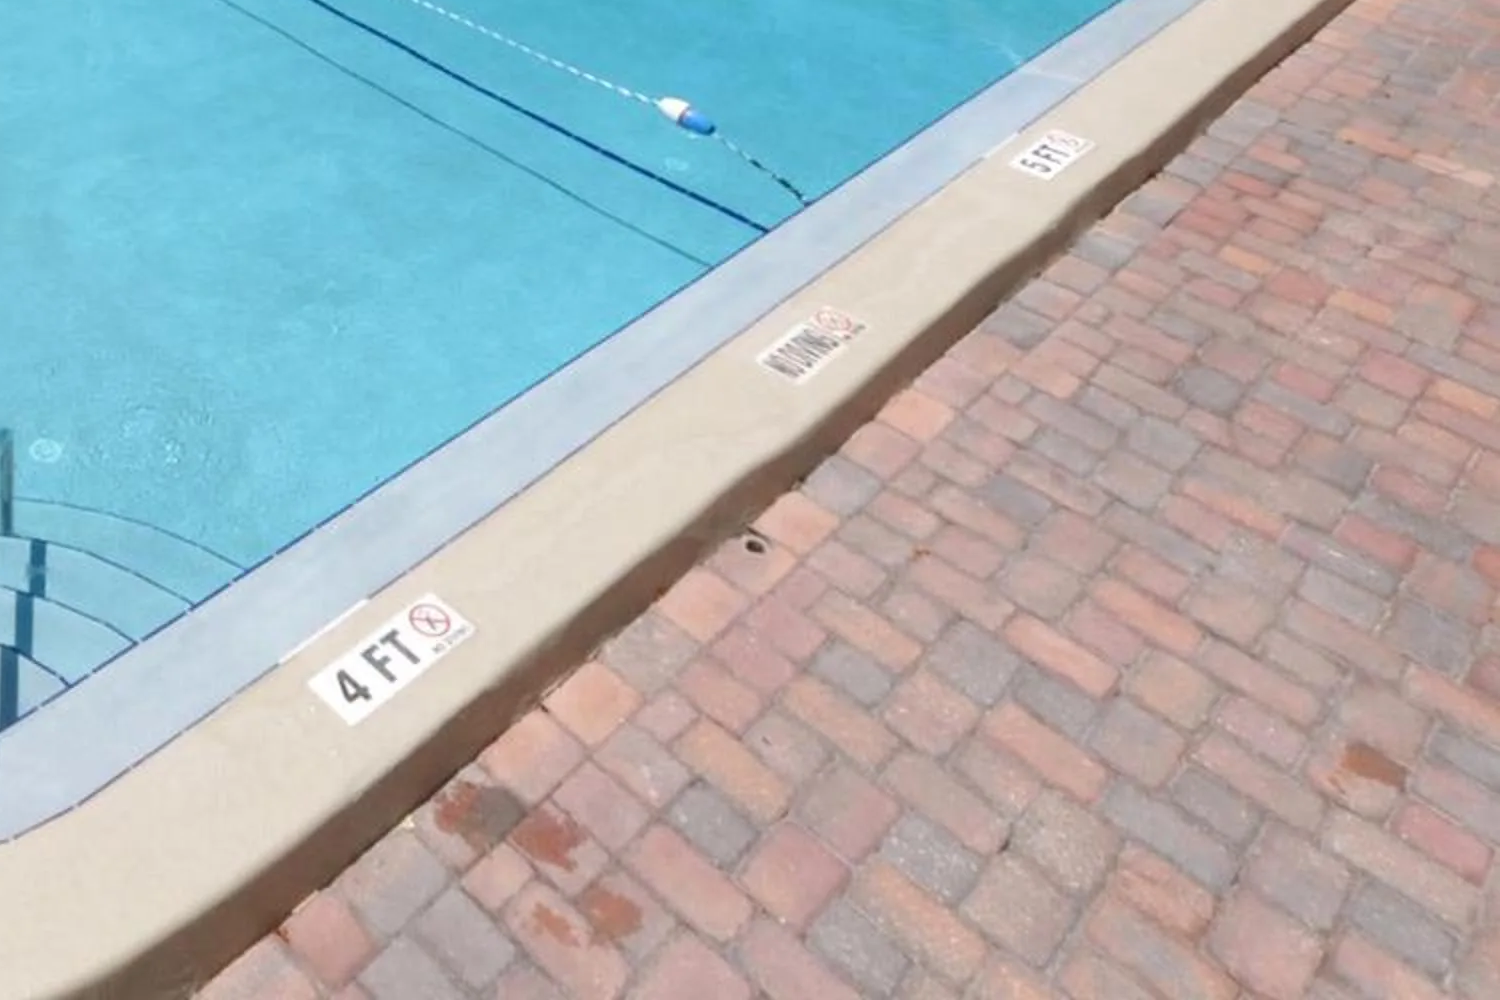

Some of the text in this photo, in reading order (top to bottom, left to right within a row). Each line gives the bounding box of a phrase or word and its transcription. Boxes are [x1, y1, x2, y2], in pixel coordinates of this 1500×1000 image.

[1019, 143, 1072, 173] 5 FT
[336, 668, 374, 704] 4
[360, 627, 422, 685] FT
